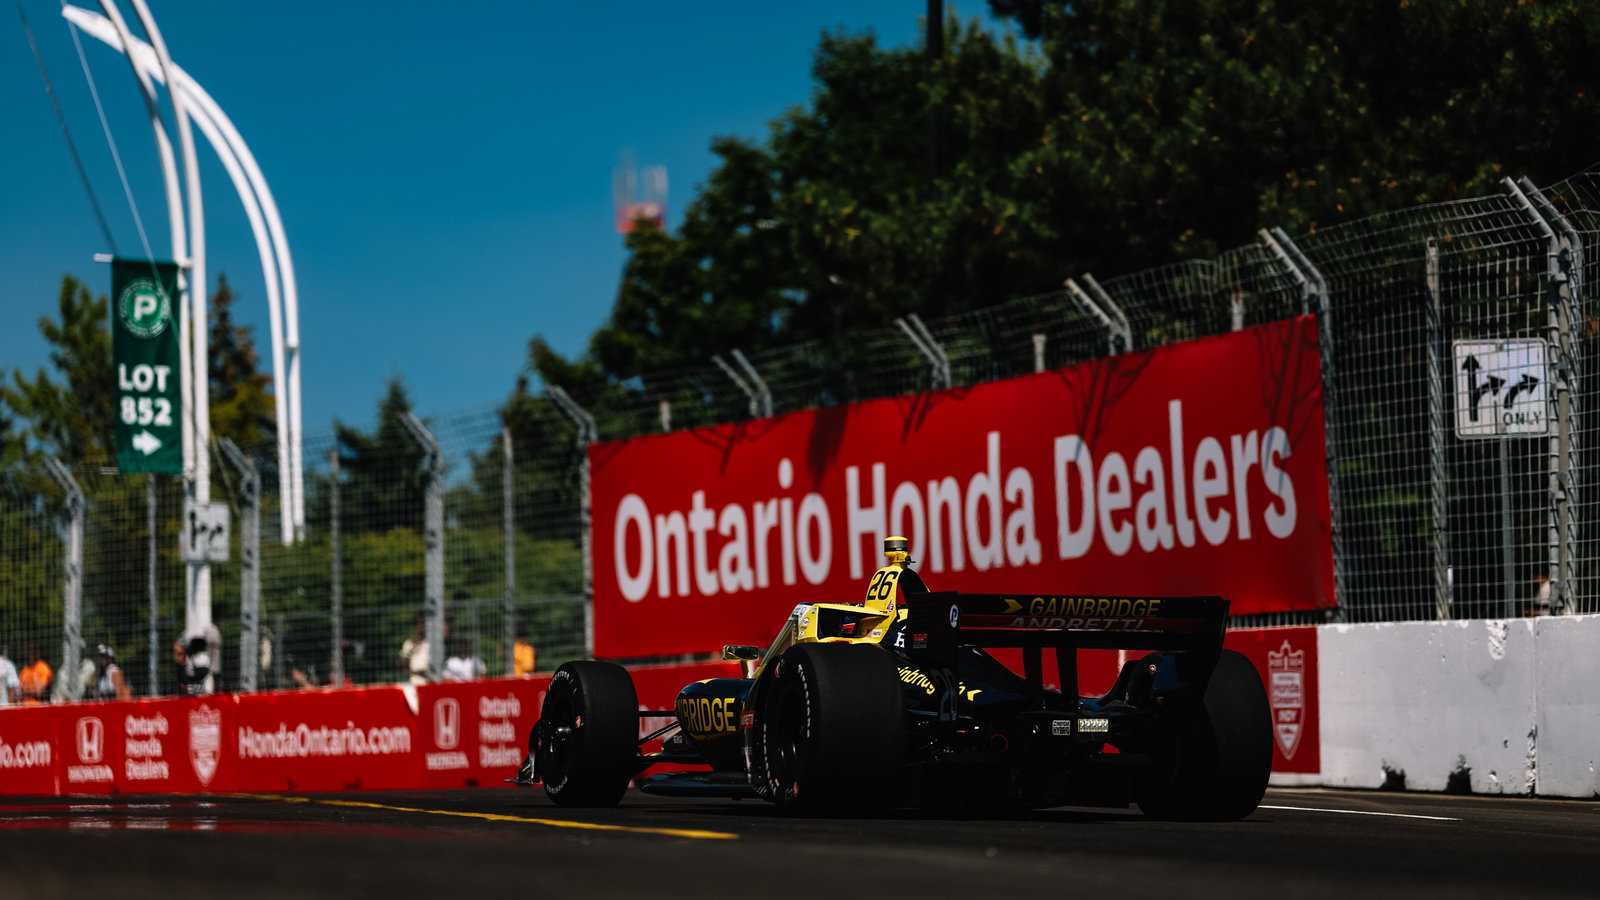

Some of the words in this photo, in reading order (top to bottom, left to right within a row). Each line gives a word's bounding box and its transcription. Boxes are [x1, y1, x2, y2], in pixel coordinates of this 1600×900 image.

[118, 363, 171, 393] LOT
[120, 395, 173, 426] 852
[1503, 411, 1543, 426] ONLY
[613, 457, 833, 604] Ontario
[846, 430, 1042, 582] Honda
[1054, 398, 1299, 561] Dealers
[866, 571, 898, 600] 26
[1028, 597, 1162, 617] GAINBRIDGE
[1008, 617, 1145, 631] ANDRETTI
[238, 719, 412, 759] HondaOntario.com
